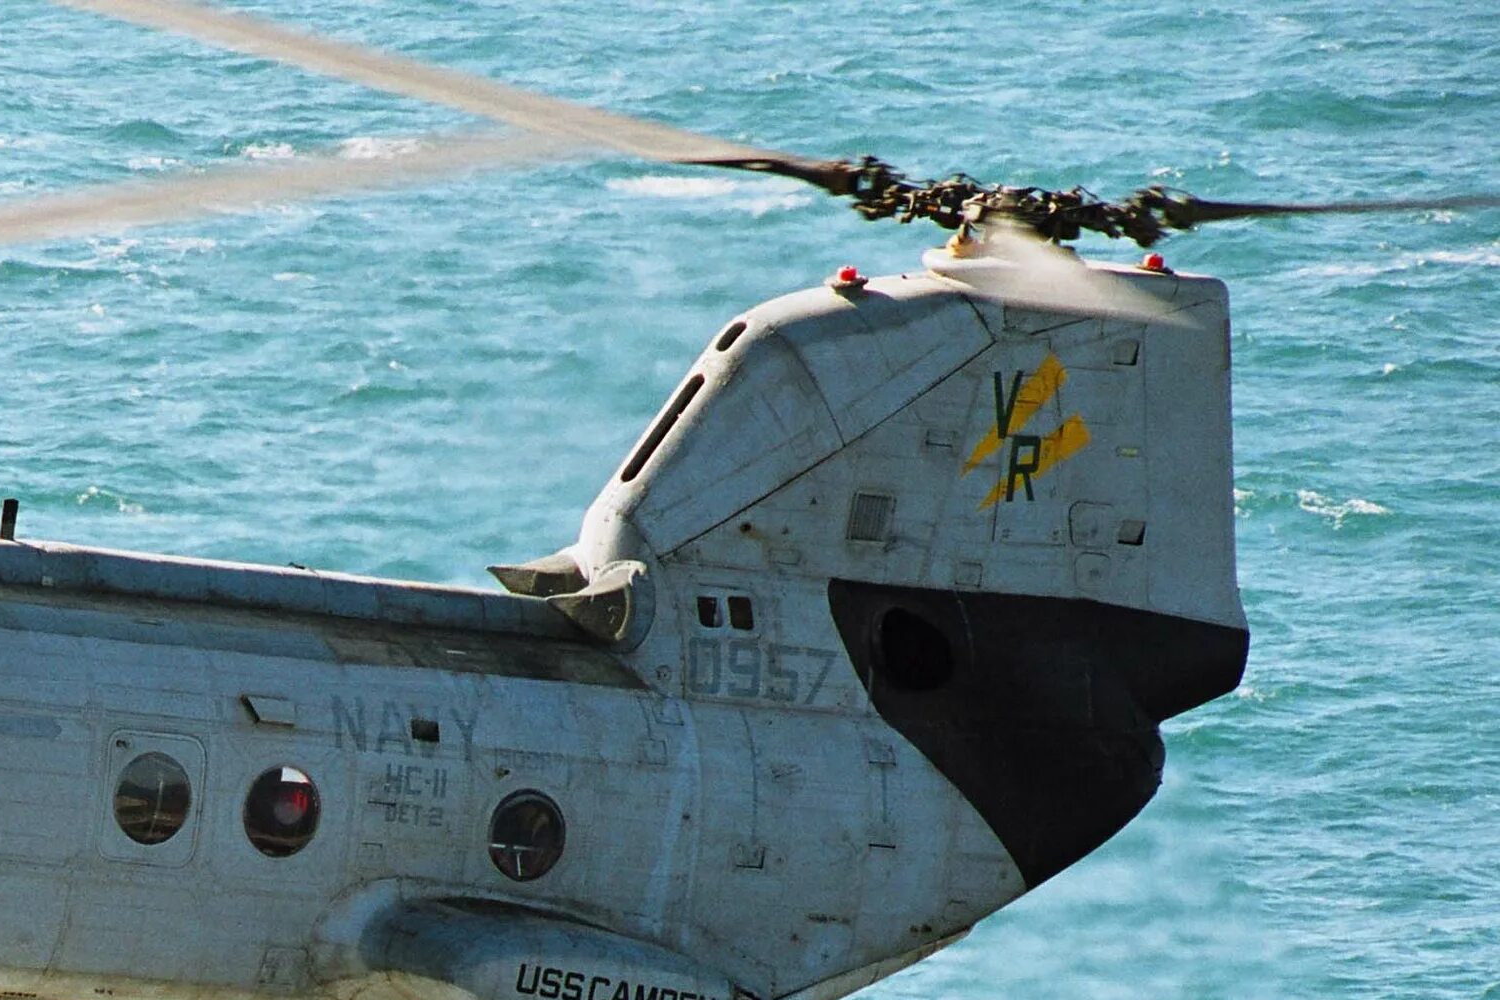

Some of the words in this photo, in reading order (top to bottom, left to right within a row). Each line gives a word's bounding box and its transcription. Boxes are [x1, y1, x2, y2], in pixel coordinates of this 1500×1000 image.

[993, 369, 1024, 439] V
[1005, 434, 1041, 502] R
[688, 636, 838, 705] 0957
[330, 692, 480, 762] NAVY
